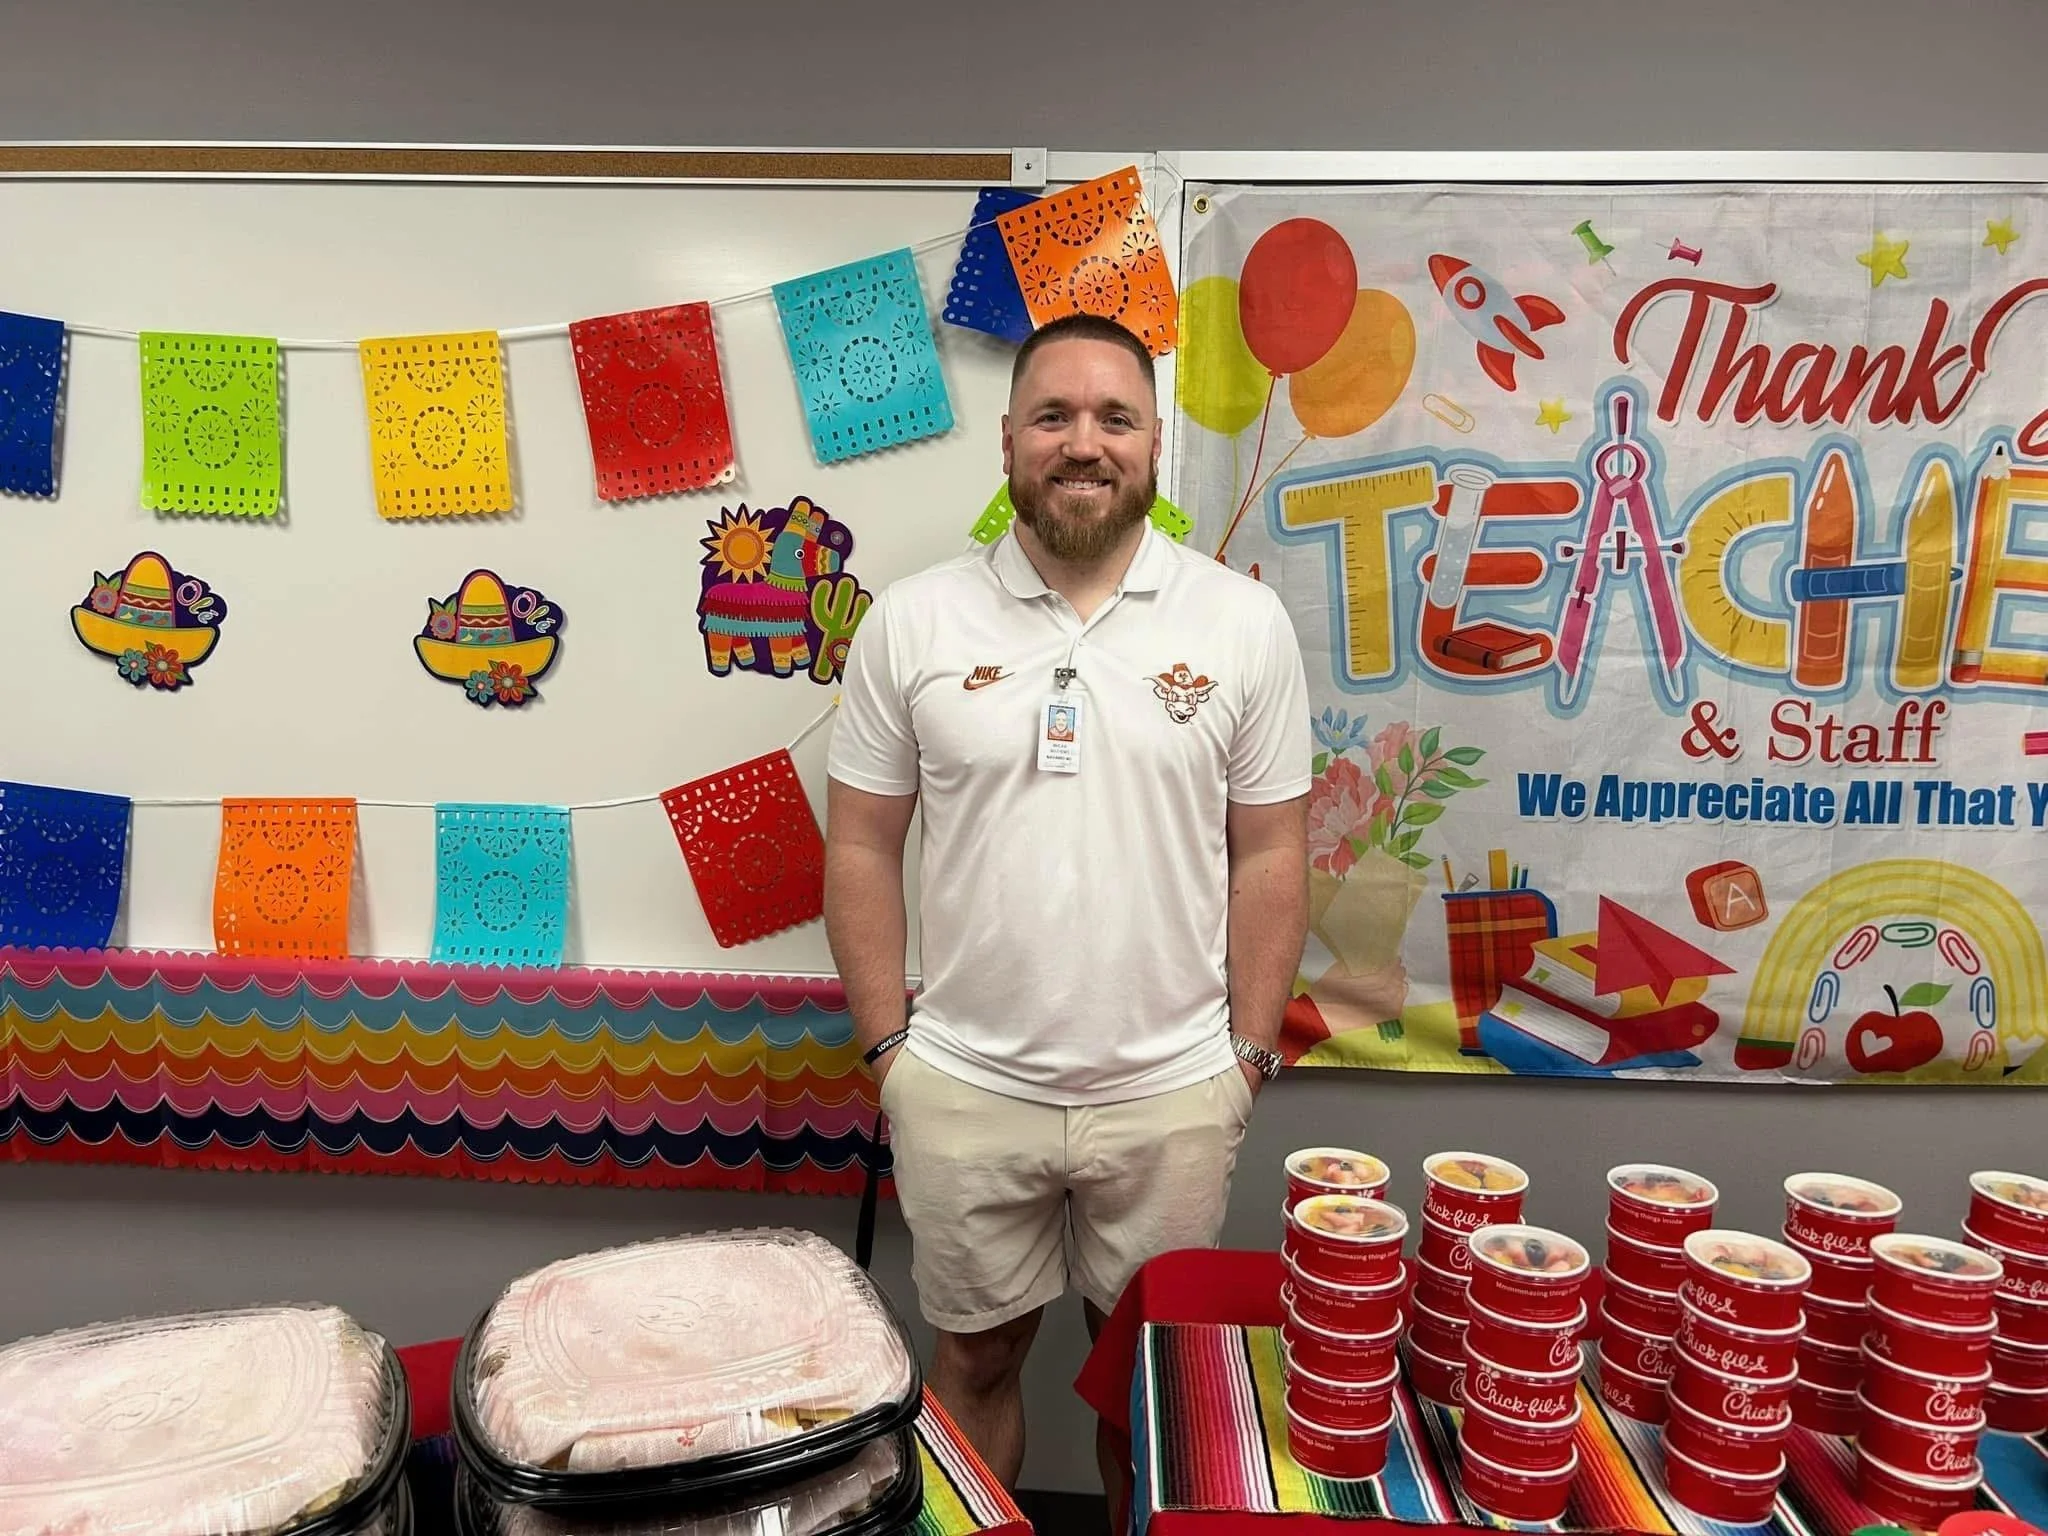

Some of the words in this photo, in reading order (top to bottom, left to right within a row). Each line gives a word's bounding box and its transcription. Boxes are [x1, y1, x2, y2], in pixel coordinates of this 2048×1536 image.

[1614, 278, 1982, 427] Thank
[177, 580, 219, 624] Olé
[512, 591, 556, 633] Olé
[971, 665, 1003, 681] NIKE
[1680, 700, 1740, 760] &
[1767, 699, 1946, 763] Staff
[1517, 772, 1586, 818] We
[1596, 777, 1836, 824] Appreciate
[1844, 781, 1902, 824] All
[1913, 781, 2015, 826] That
[1725, 882, 1755, 919] A
[1475, 1372, 1567, 1419] Chick-fil-A
